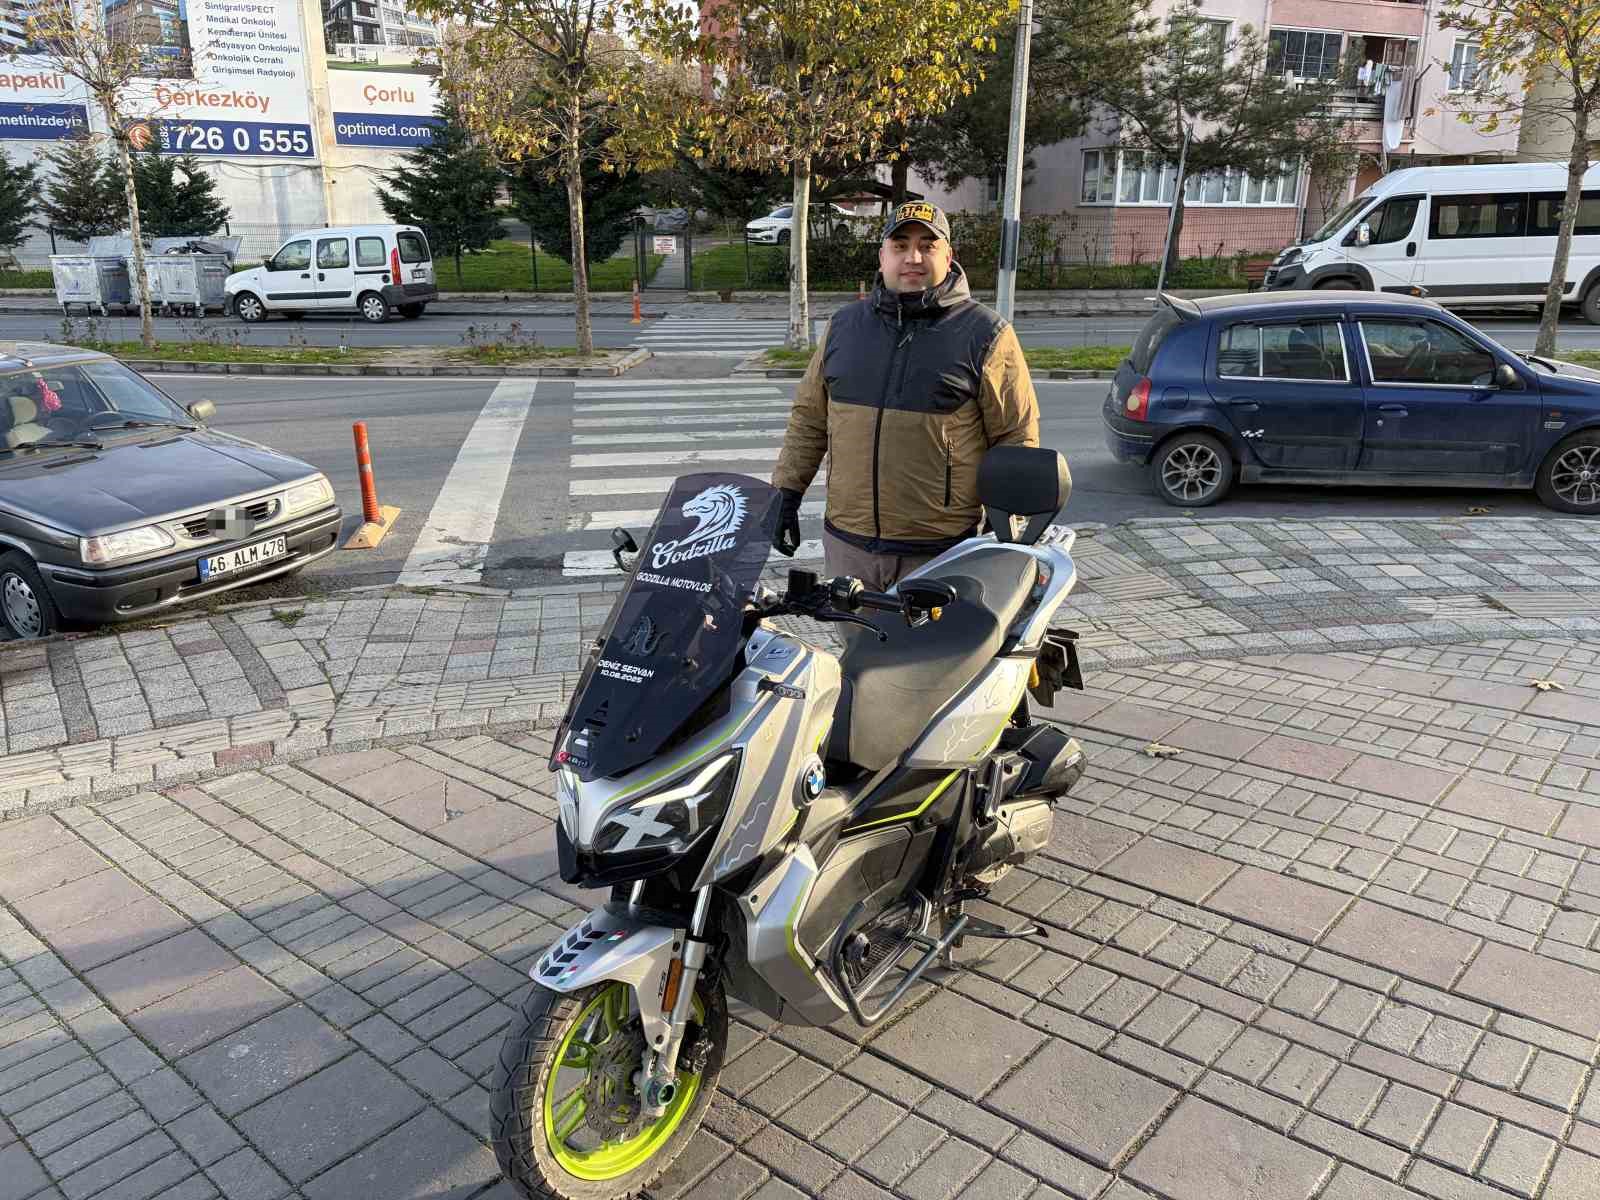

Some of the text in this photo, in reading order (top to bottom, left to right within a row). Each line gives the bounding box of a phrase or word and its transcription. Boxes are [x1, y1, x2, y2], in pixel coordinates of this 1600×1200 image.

[206, 14, 276, 28] Medikal Onkoloji
[258, 43, 300, 54] Onkolojisi
[211, 53, 284, 65] Onkolojik Cerrahi
[256, 68, 296, 79] Radyoloji
[156, 87, 271, 113] Çerkezköy
[363, 84, 415, 106] Çorlu
[338, 122, 431, 139] optimed.com
[170, 125, 308, 153] 726 0 555
[210, 556, 226, 573] 46
[235, 546, 258, 567] ALM
[263, 538, 285, 557] 478
[636, 571, 670, 586] GODZILLA
[622, 664, 654, 678] SERVAN
